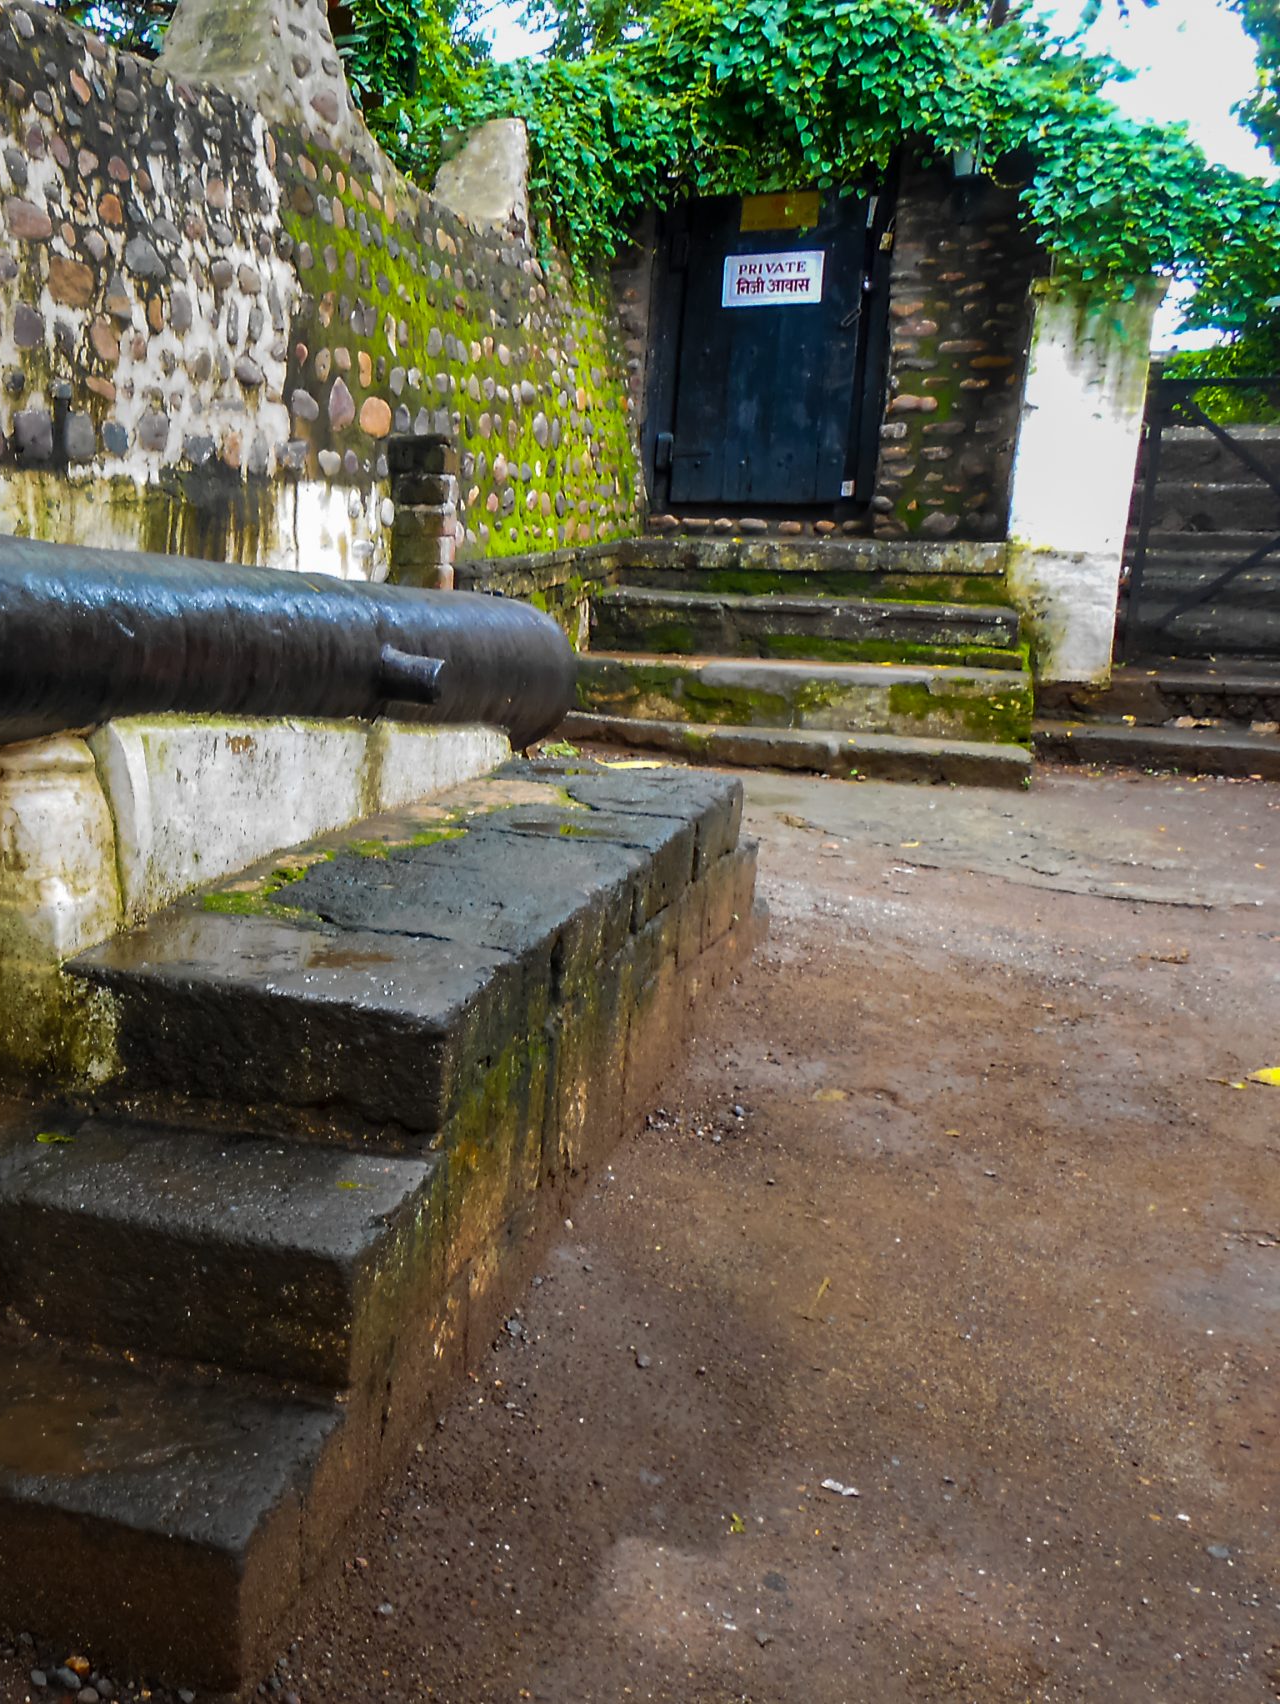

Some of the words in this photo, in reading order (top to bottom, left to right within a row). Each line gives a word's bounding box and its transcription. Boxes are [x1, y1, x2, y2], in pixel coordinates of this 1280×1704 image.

[739, 261, 806, 275] PRIVATE
[736, 276, 765, 295] निजी
[767, 278, 810, 293] आवास
